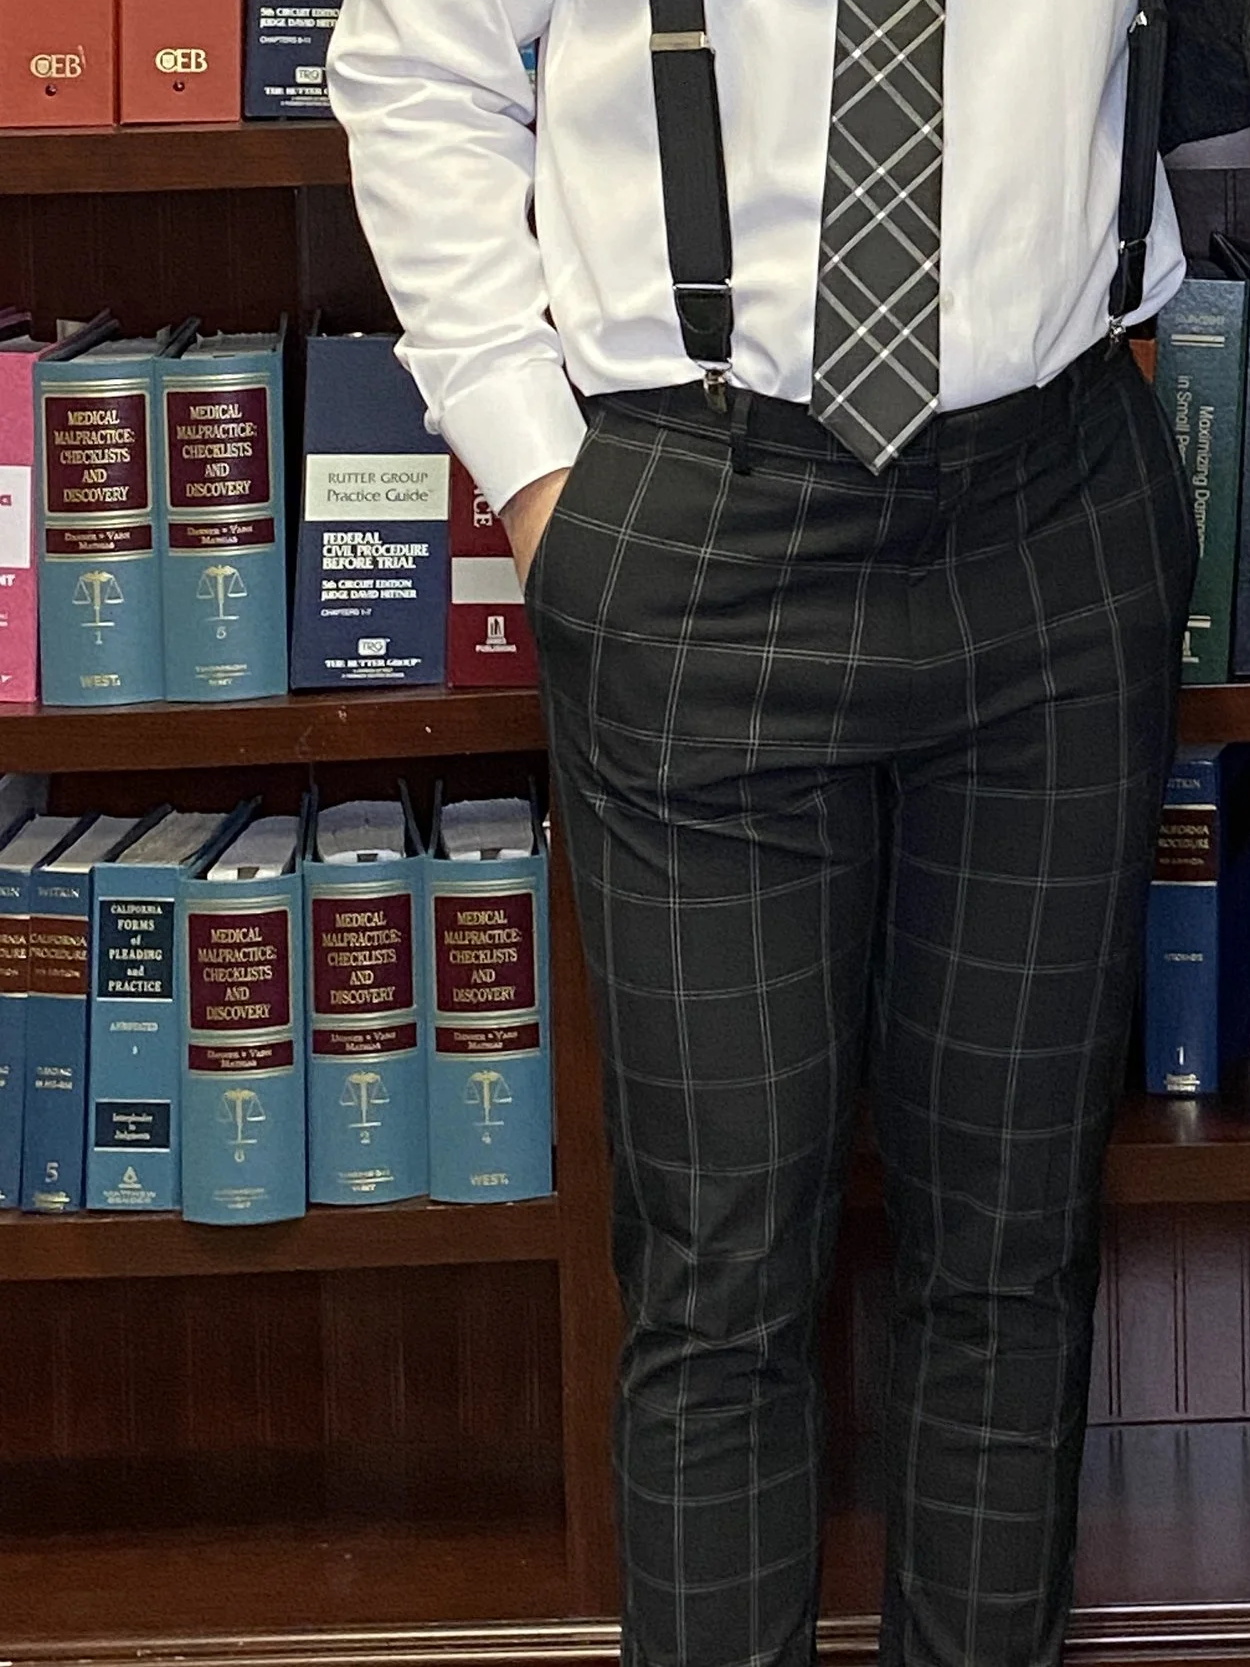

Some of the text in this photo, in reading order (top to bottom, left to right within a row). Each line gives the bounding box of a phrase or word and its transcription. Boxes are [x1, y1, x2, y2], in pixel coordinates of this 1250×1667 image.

[155, 48, 208, 73] CEB
[68, 410, 120, 425] MEDICAL
[189, 404, 242, 419] MEDICAL
[1175, 391, 1191, 439] Small
[54, 430, 135, 445] MALPRACTICE:
[176, 423, 257, 439] MALPRACTICE:
[182, 442, 252, 458] CHECKLISTS
[1192, 405, 1214, 486] Maximizing
[60, 448, 130, 464] CHECKLISTS
[82, 469, 107, 483] AND
[204, 463, 230, 477] AND
[328, 473, 429, 483] RUTTER GROUP
[63, 486, 129, 502] DISCOVERY
[186, 481, 251, 497] DISCOVERY
[326, 489, 429, 502] Practice Guide
[322, 532, 382, 545] FEDERAL
[322, 544, 429, 557] CIVIL PROCEDURE
[322, 557, 416, 570] BEFORE TRIAL
[117, 919, 155, 931] FORMS
[335, 911, 387, 927] MEDICAL
[457, 910, 508, 925] MEDICAL
[211, 928, 262, 943] MEDICAL
[322, 930, 401, 947] MALPRACTICE:
[444, 928, 522, 944] MALPRACTICE:
[198, 946, 277, 962] MALPRACTICE:
[327, 949, 396, 966] CHECKLISTS
[450, 948, 517, 964] CHECKLISTS
[203, 966, 272, 982] CHECKLISTS
[350, 970, 374, 985] AND
[471, 969, 495, 983] AND
[108, 980, 162, 992] PRACTICE
[224, 986, 249, 1002] AND
[330, 987, 395, 1004] DISCOVERY
[453, 987, 515, 1002] DISCOVERY
[206, 1004, 271, 1021] DISCOVERY
[1176, 1046, 1184, 1065] 1
[45, 1162, 59, 1183] 5
